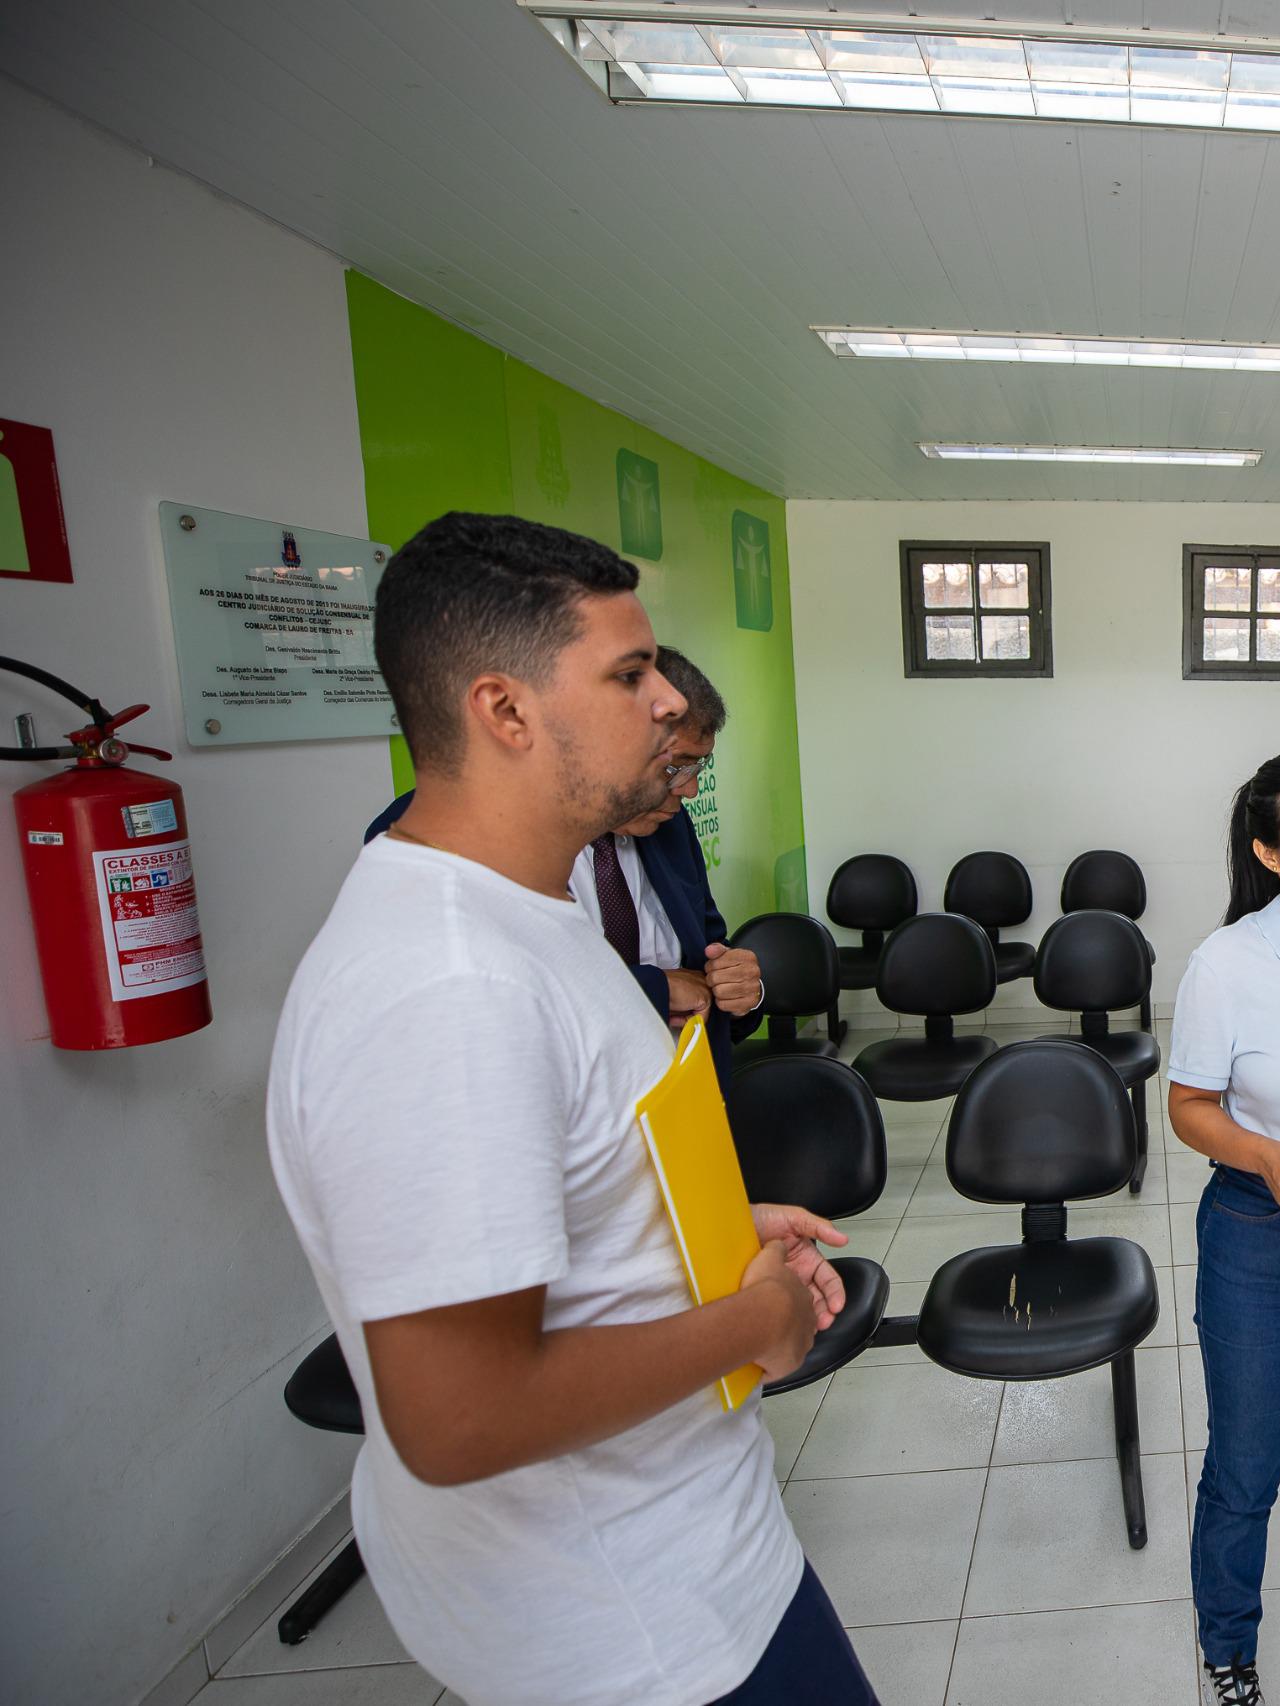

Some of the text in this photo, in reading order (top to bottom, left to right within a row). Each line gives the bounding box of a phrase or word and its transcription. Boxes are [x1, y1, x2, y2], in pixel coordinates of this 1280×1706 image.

[199, 588, 215, 597] AOS
[226, 591, 243, 600] DIAS
[244, 593, 254, 601] DO
[255, 593, 270, 602] MÊS
[270, 595, 280, 603] DE
[280, 596, 306, 606] AGOSTO
[306, 599, 314, 607] DE
[217, 600, 247, 610] CENTRO
[248, 603, 286, 613] JUDICIÁRIO
[286, 606, 296, 614] DE
[296, 607, 324, 616] SOLUÇÃO
[325, 610, 361, 620] CONSENSUAL
[268, 614, 304, 624] CONFLITOS
[308, 617, 332, 626] CEJUSC
[244, 622, 277, 631] COMARCA
[288, 625, 309, 633] LAURO
[309, 626, 318, 634] DE
[318, 627, 342, 635] FREITAS
[229, 666, 252, 674] Augusto
[685, 796, 718, 818] ENSUAL
[107, 852, 174, 869] CLASSES
[108, 866, 139, 874] EXTINTOR
